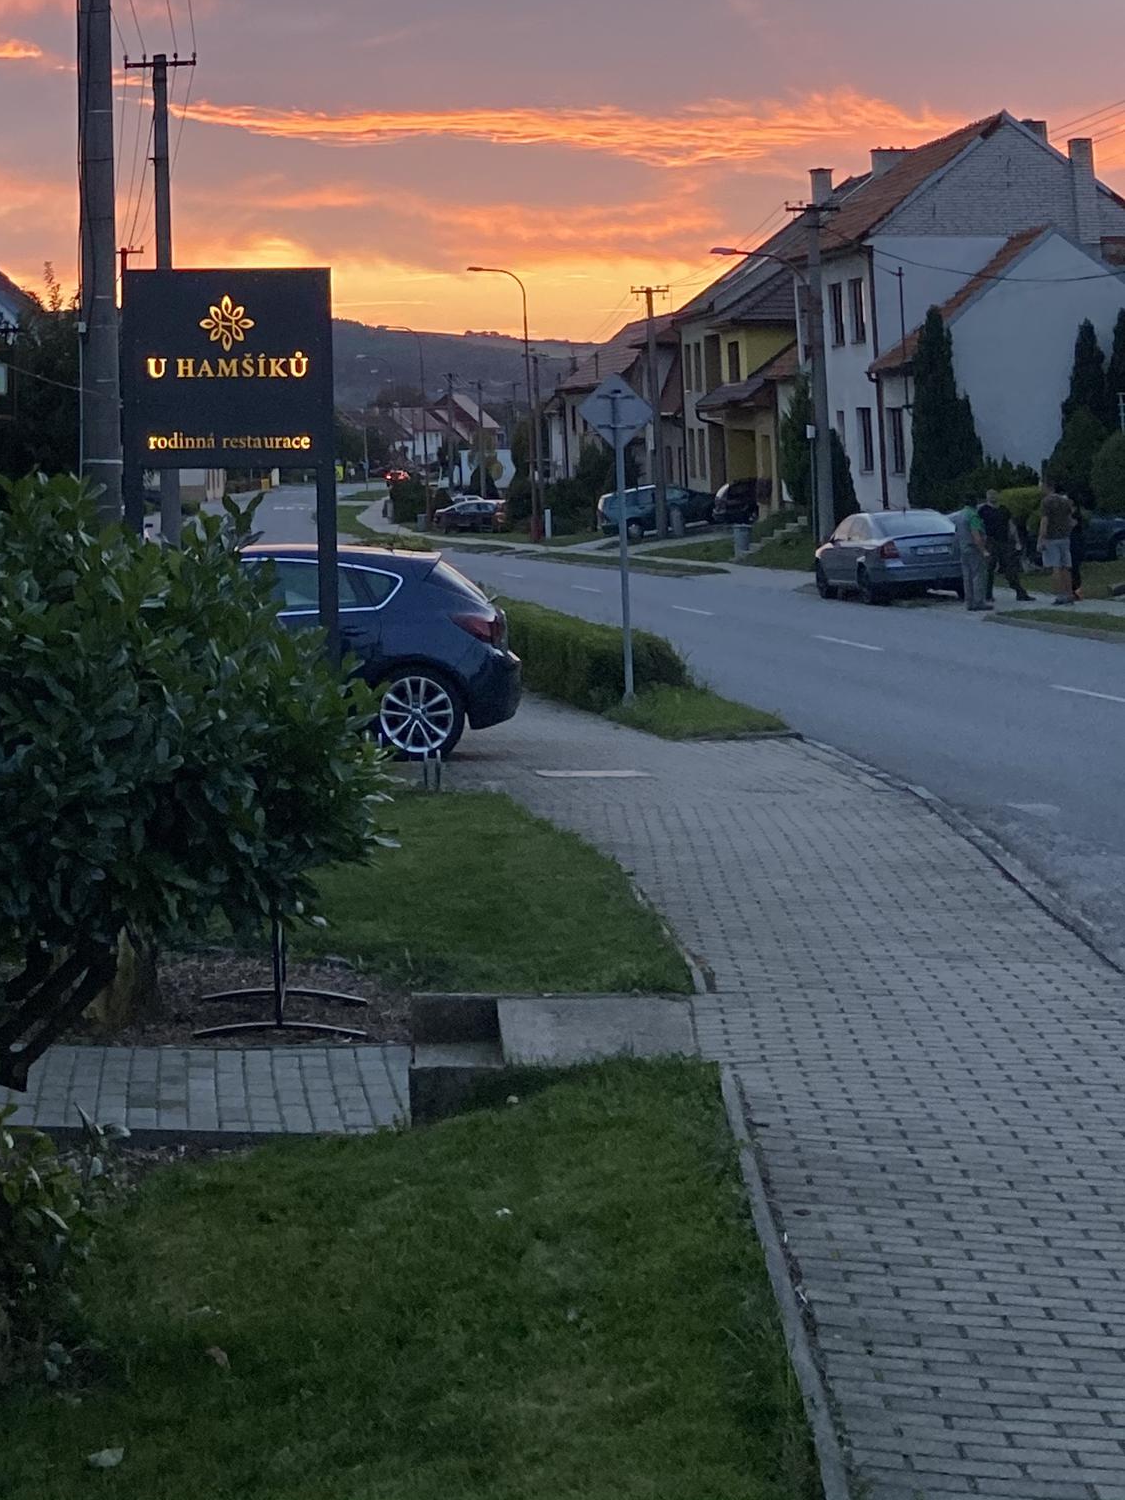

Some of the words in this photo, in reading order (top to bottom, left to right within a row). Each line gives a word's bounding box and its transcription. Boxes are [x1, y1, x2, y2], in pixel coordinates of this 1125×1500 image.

[147, 358, 167, 378] U
[176, 351, 309, 378] HAMŠÍKŮ
[148, 432, 215, 450] rodinná
[222, 435, 311, 450] restaurace
